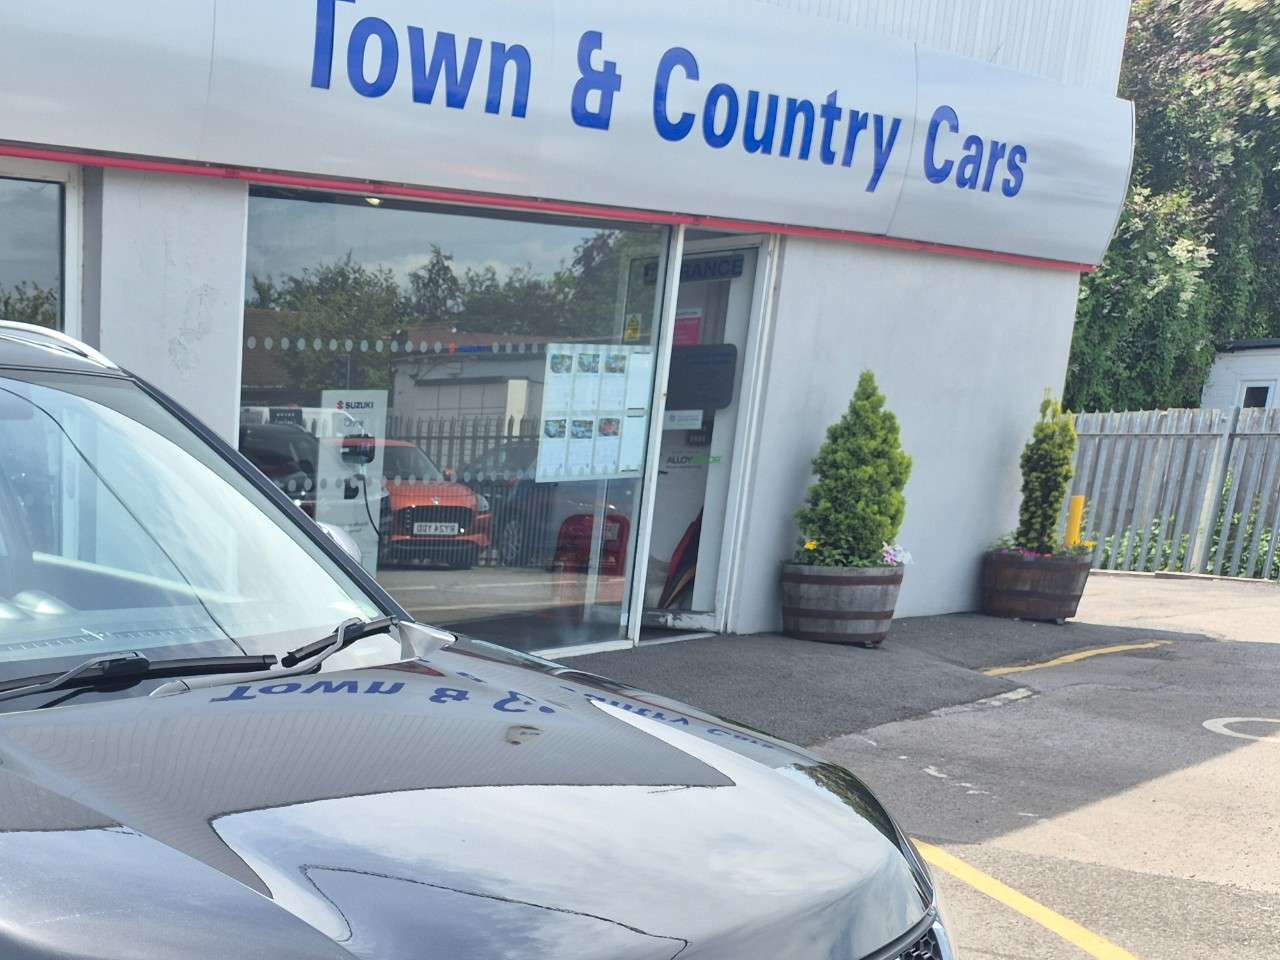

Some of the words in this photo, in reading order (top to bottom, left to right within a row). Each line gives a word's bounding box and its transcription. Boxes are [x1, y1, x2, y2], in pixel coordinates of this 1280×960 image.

[311, 0, 532, 118] Town
[570, 29, 622, 131] &
[651, 46, 902, 193] Country
[923, 104, 1029, 199] Cars
[345, 401, 374, 410] SUZUKI
